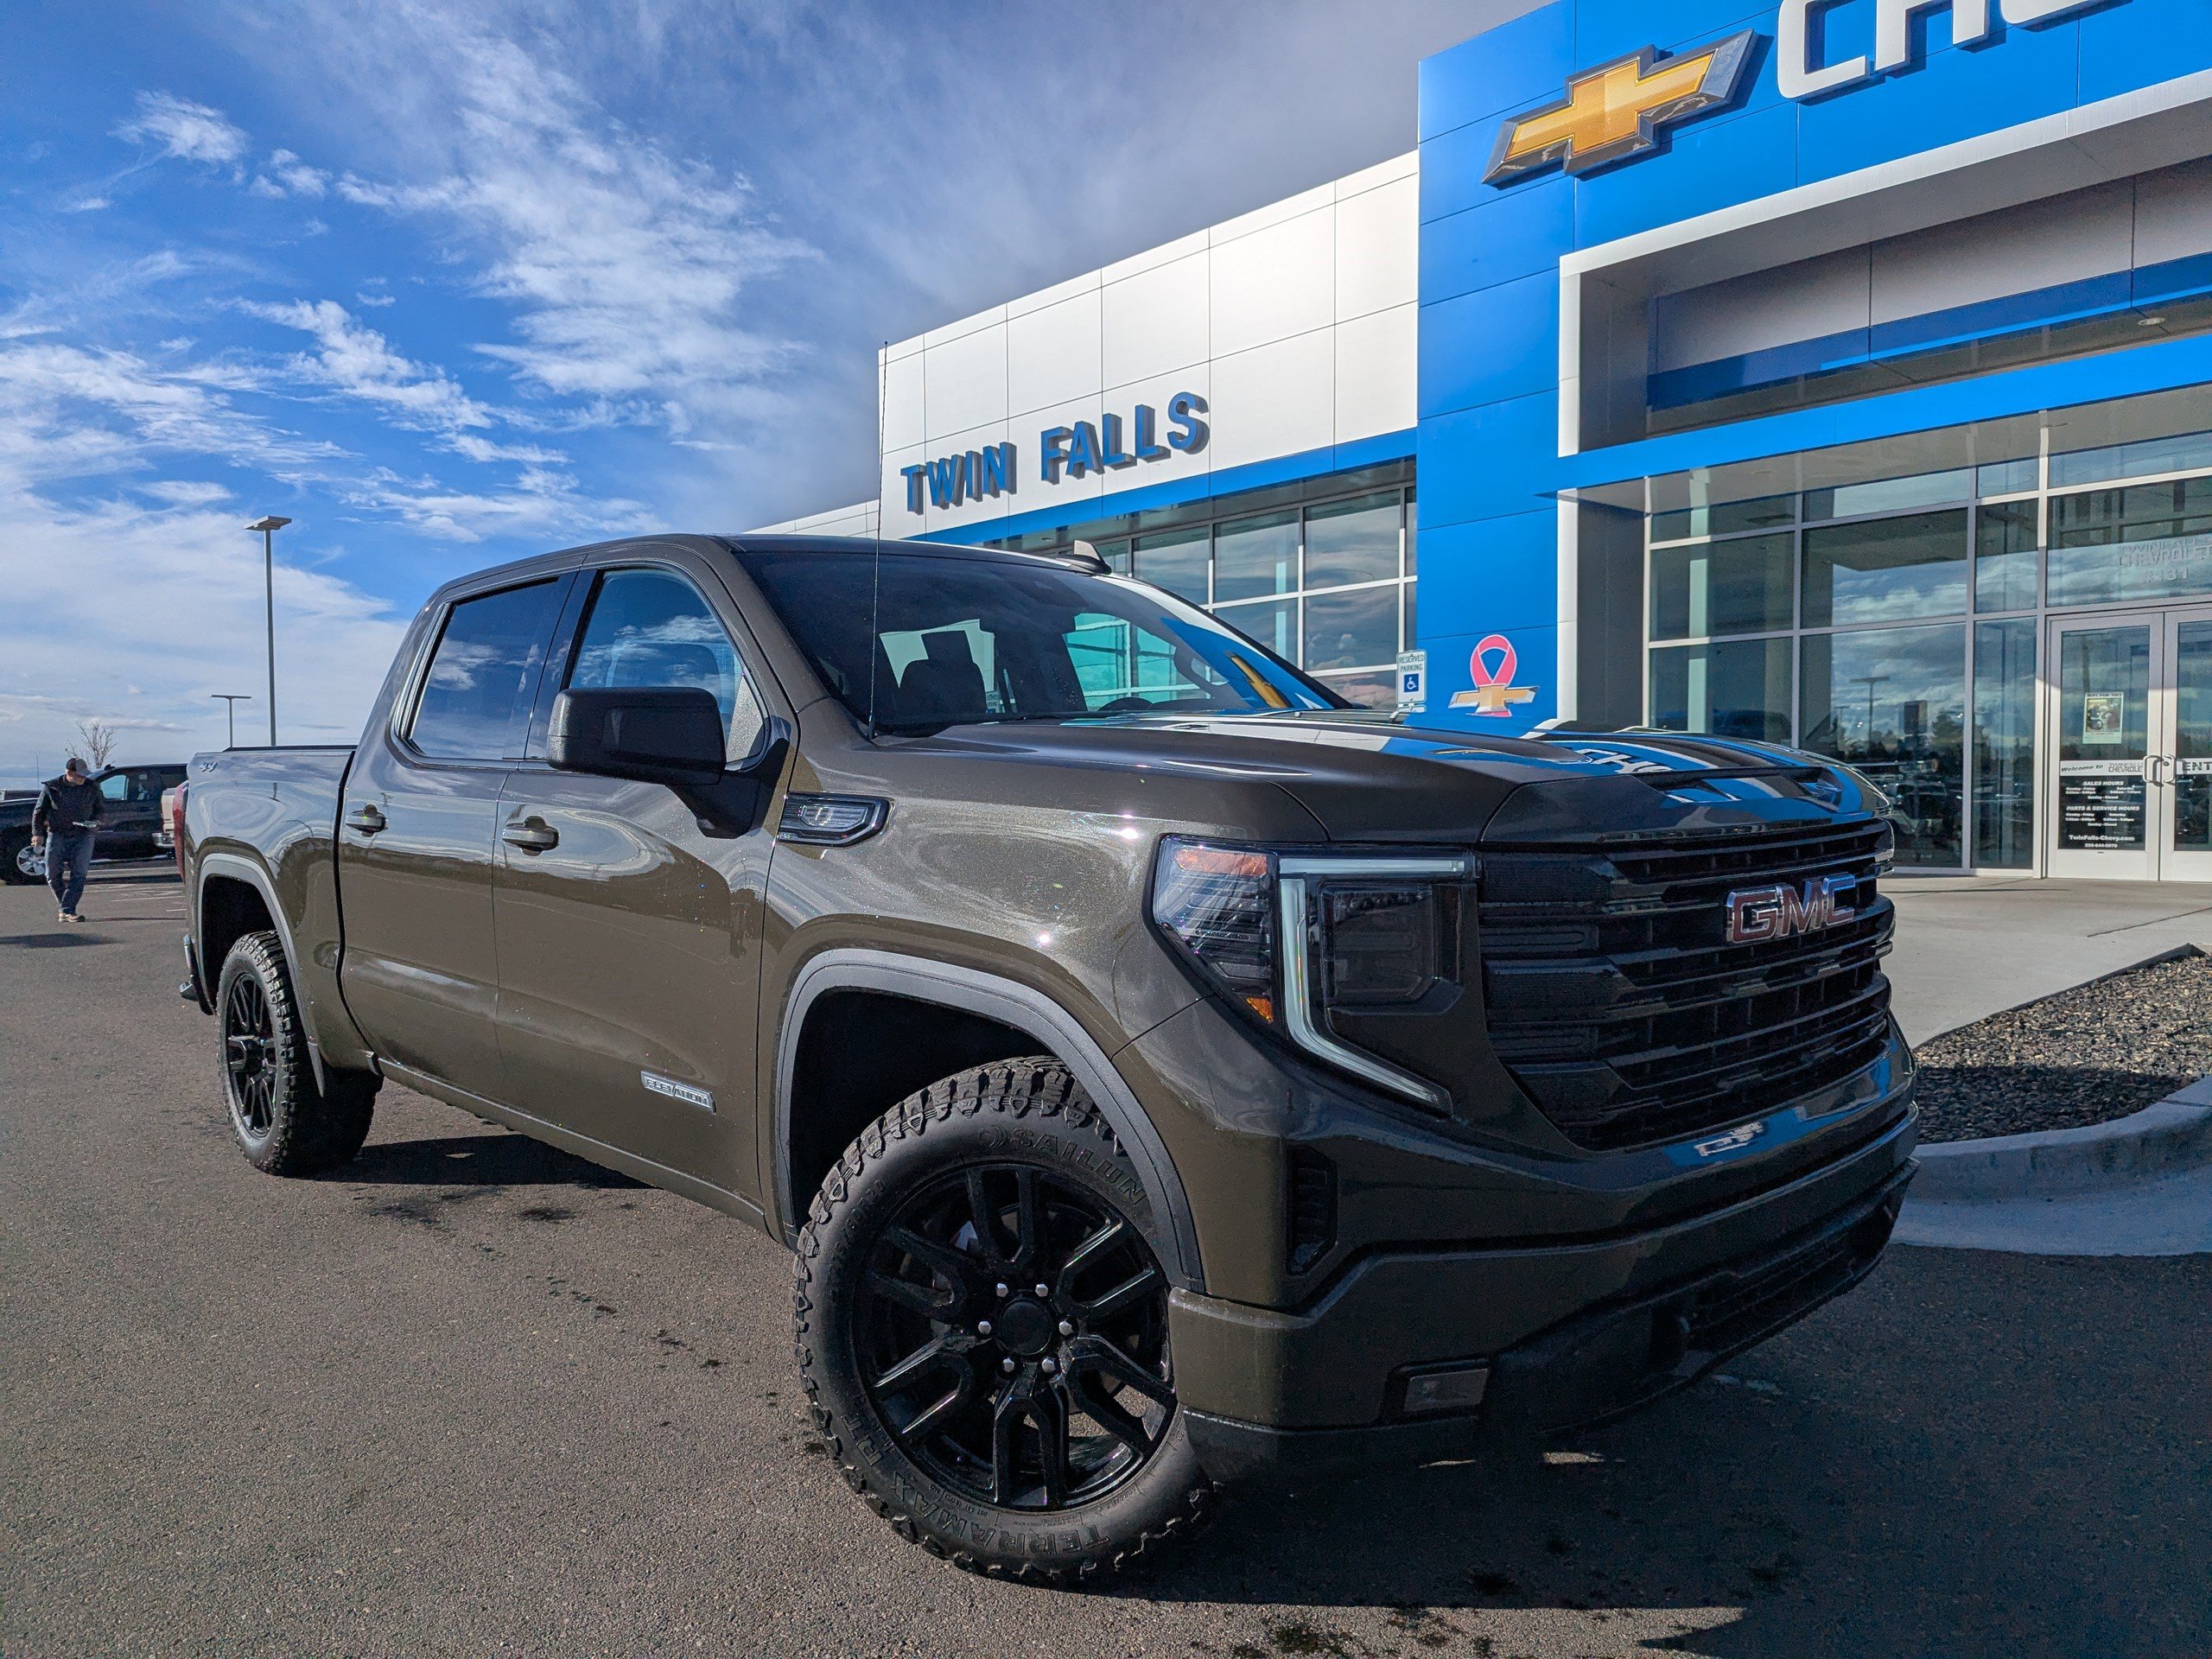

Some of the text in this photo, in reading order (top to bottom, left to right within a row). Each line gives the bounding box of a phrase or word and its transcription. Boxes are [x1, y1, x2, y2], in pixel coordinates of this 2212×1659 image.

[900, 391, 1210, 515] TWIN FALLS
[1399, 654, 1424, 664] RESERVED
[1400, 664, 1423, 673] PARKING
[1726, 874, 1856, 944] GMC
[1008, 1127, 1148, 1205] SAILUN
[840, 1414, 884, 1468] RT
[890, 1470, 1111, 1557] TERRAMAX
